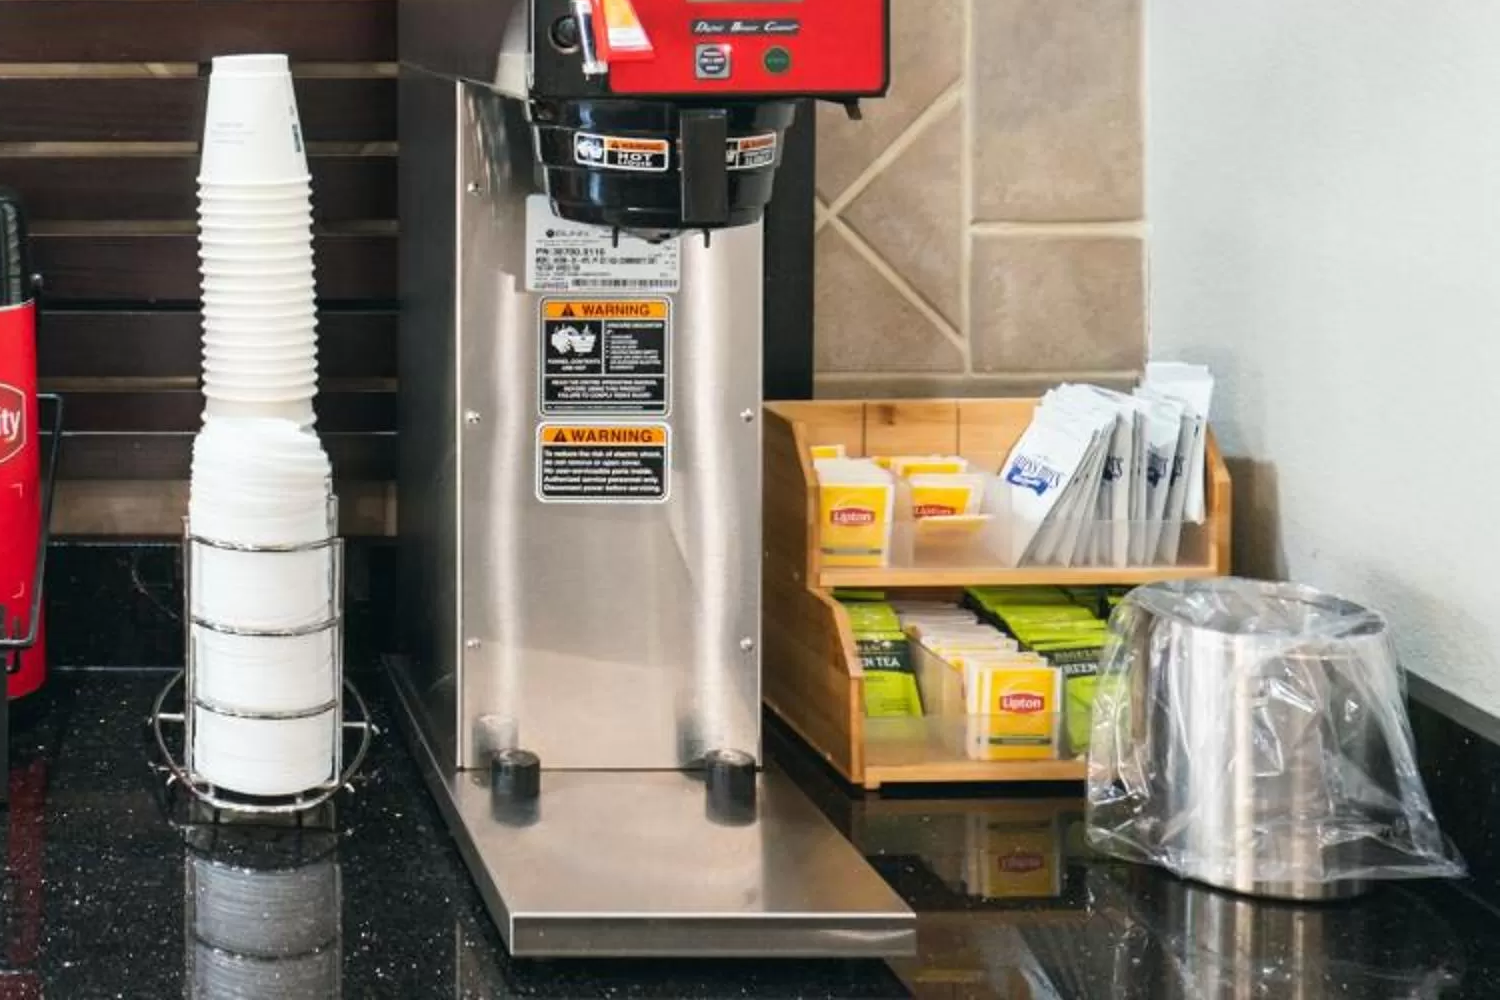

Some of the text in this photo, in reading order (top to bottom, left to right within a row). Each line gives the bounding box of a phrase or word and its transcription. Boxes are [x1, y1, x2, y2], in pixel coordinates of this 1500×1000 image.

[617, 152, 653, 161] HOT
[581, 303, 651, 317] WARNING
[571, 429, 653, 442] WARNING
[832, 511, 872, 524] Lipton
[876, 656, 901, 668] TEA
[1002, 695, 1042, 710] Lipton
